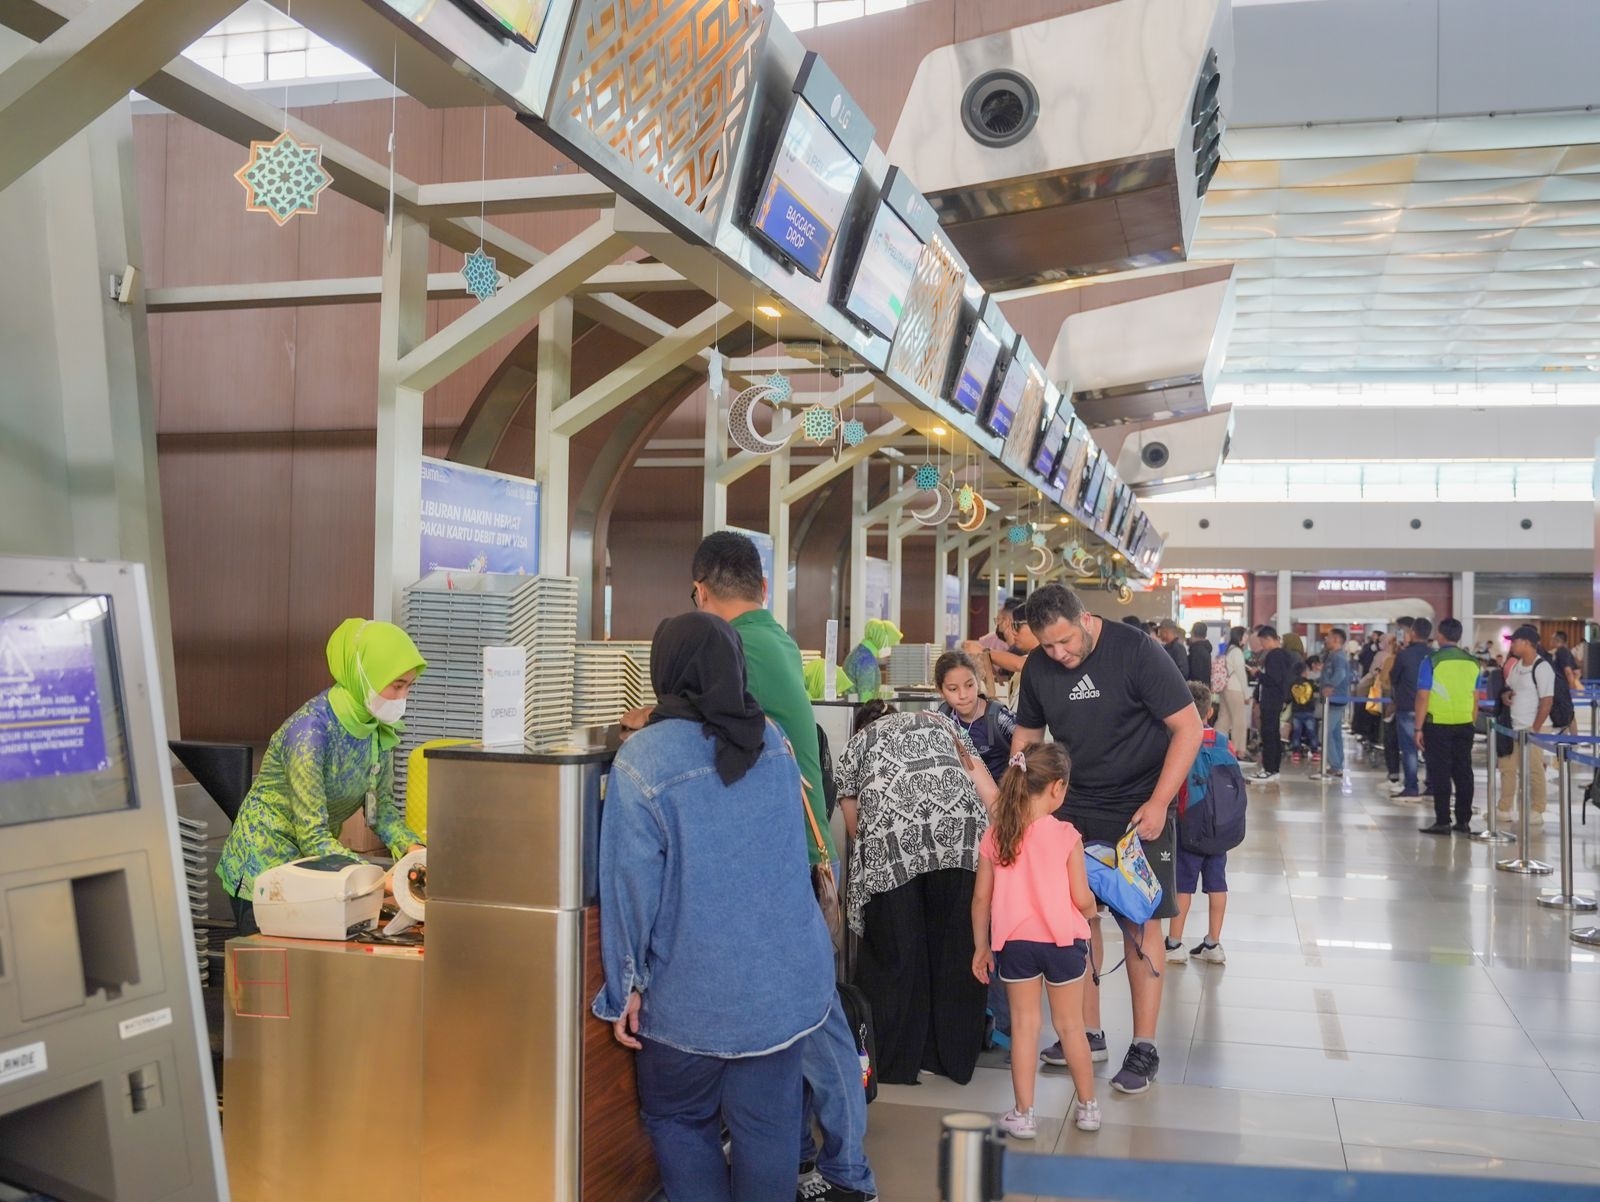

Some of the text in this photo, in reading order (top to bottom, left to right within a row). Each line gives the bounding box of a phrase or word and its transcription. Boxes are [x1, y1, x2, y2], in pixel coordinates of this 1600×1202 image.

[786, 205, 816, 240] BAGGAGE
[786, 228, 805, 249] DROP
[420, 500, 522, 531] LIBURAN MAKIN HEMAT
[420, 521, 528, 549] PAKAI KARTU DEBIT BTN VISA
[1317, 579, 1387, 591] ATM CENTER
[1069, 690, 1100, 700] adidas
[490, 707, 518, 719] OPENED
